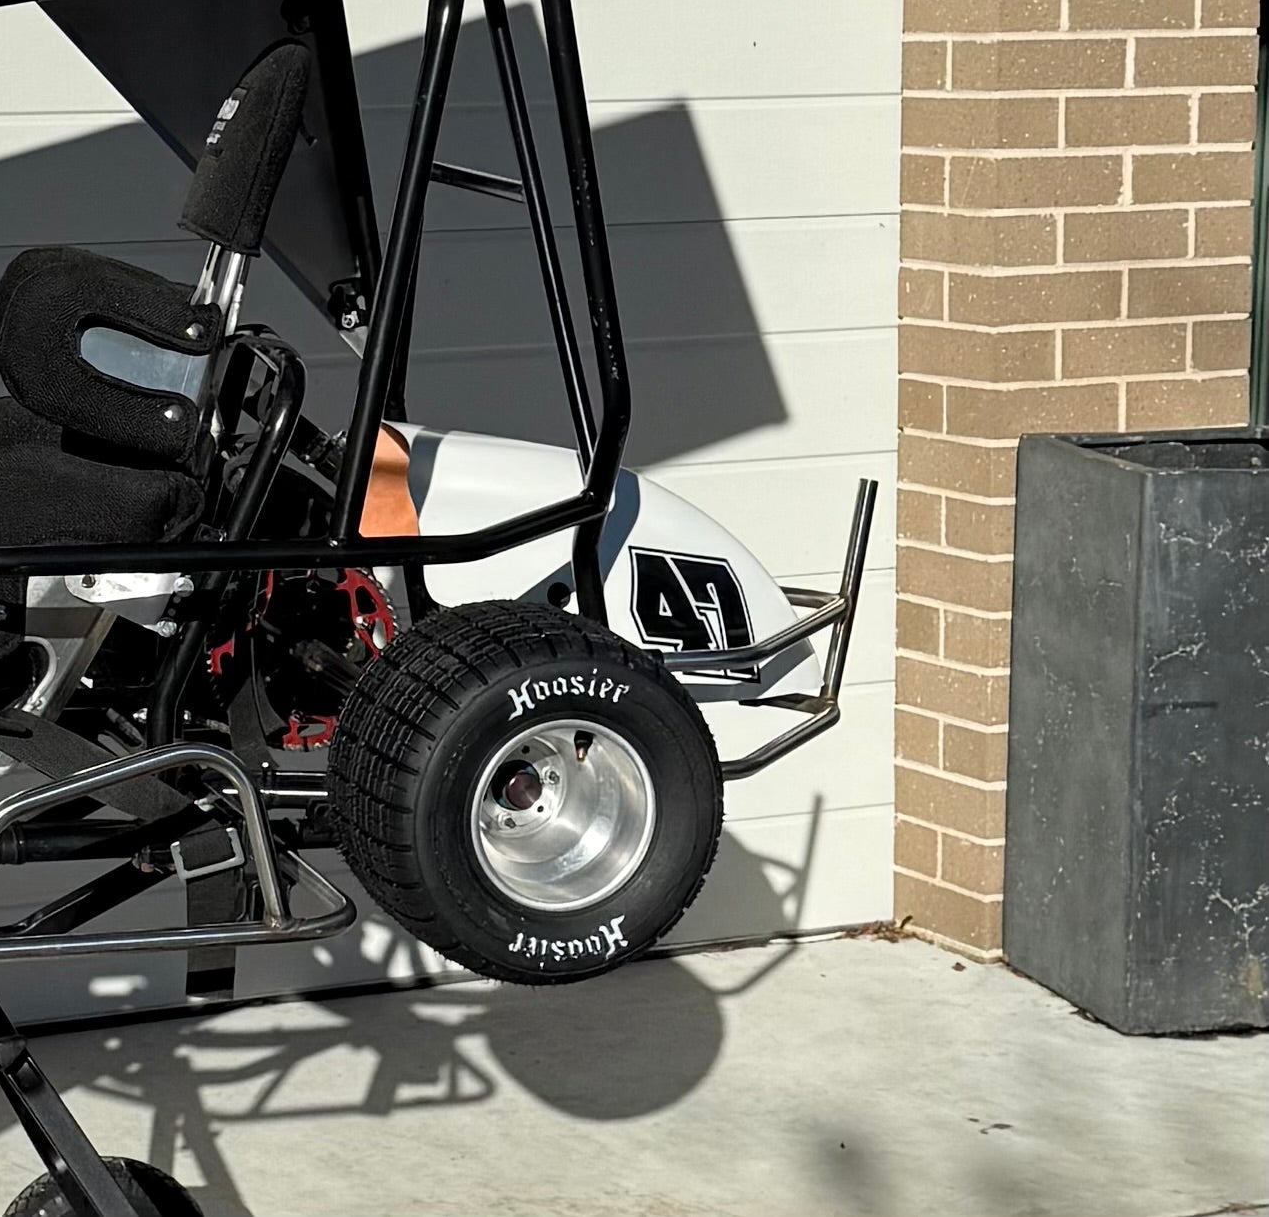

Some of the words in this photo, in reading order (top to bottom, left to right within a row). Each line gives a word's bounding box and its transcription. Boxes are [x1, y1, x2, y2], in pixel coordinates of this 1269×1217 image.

[628, 546, 761, 684] 47
[507, 668, 631, 722] Hoosier
[508, 913, 630, 970] Hoosier
